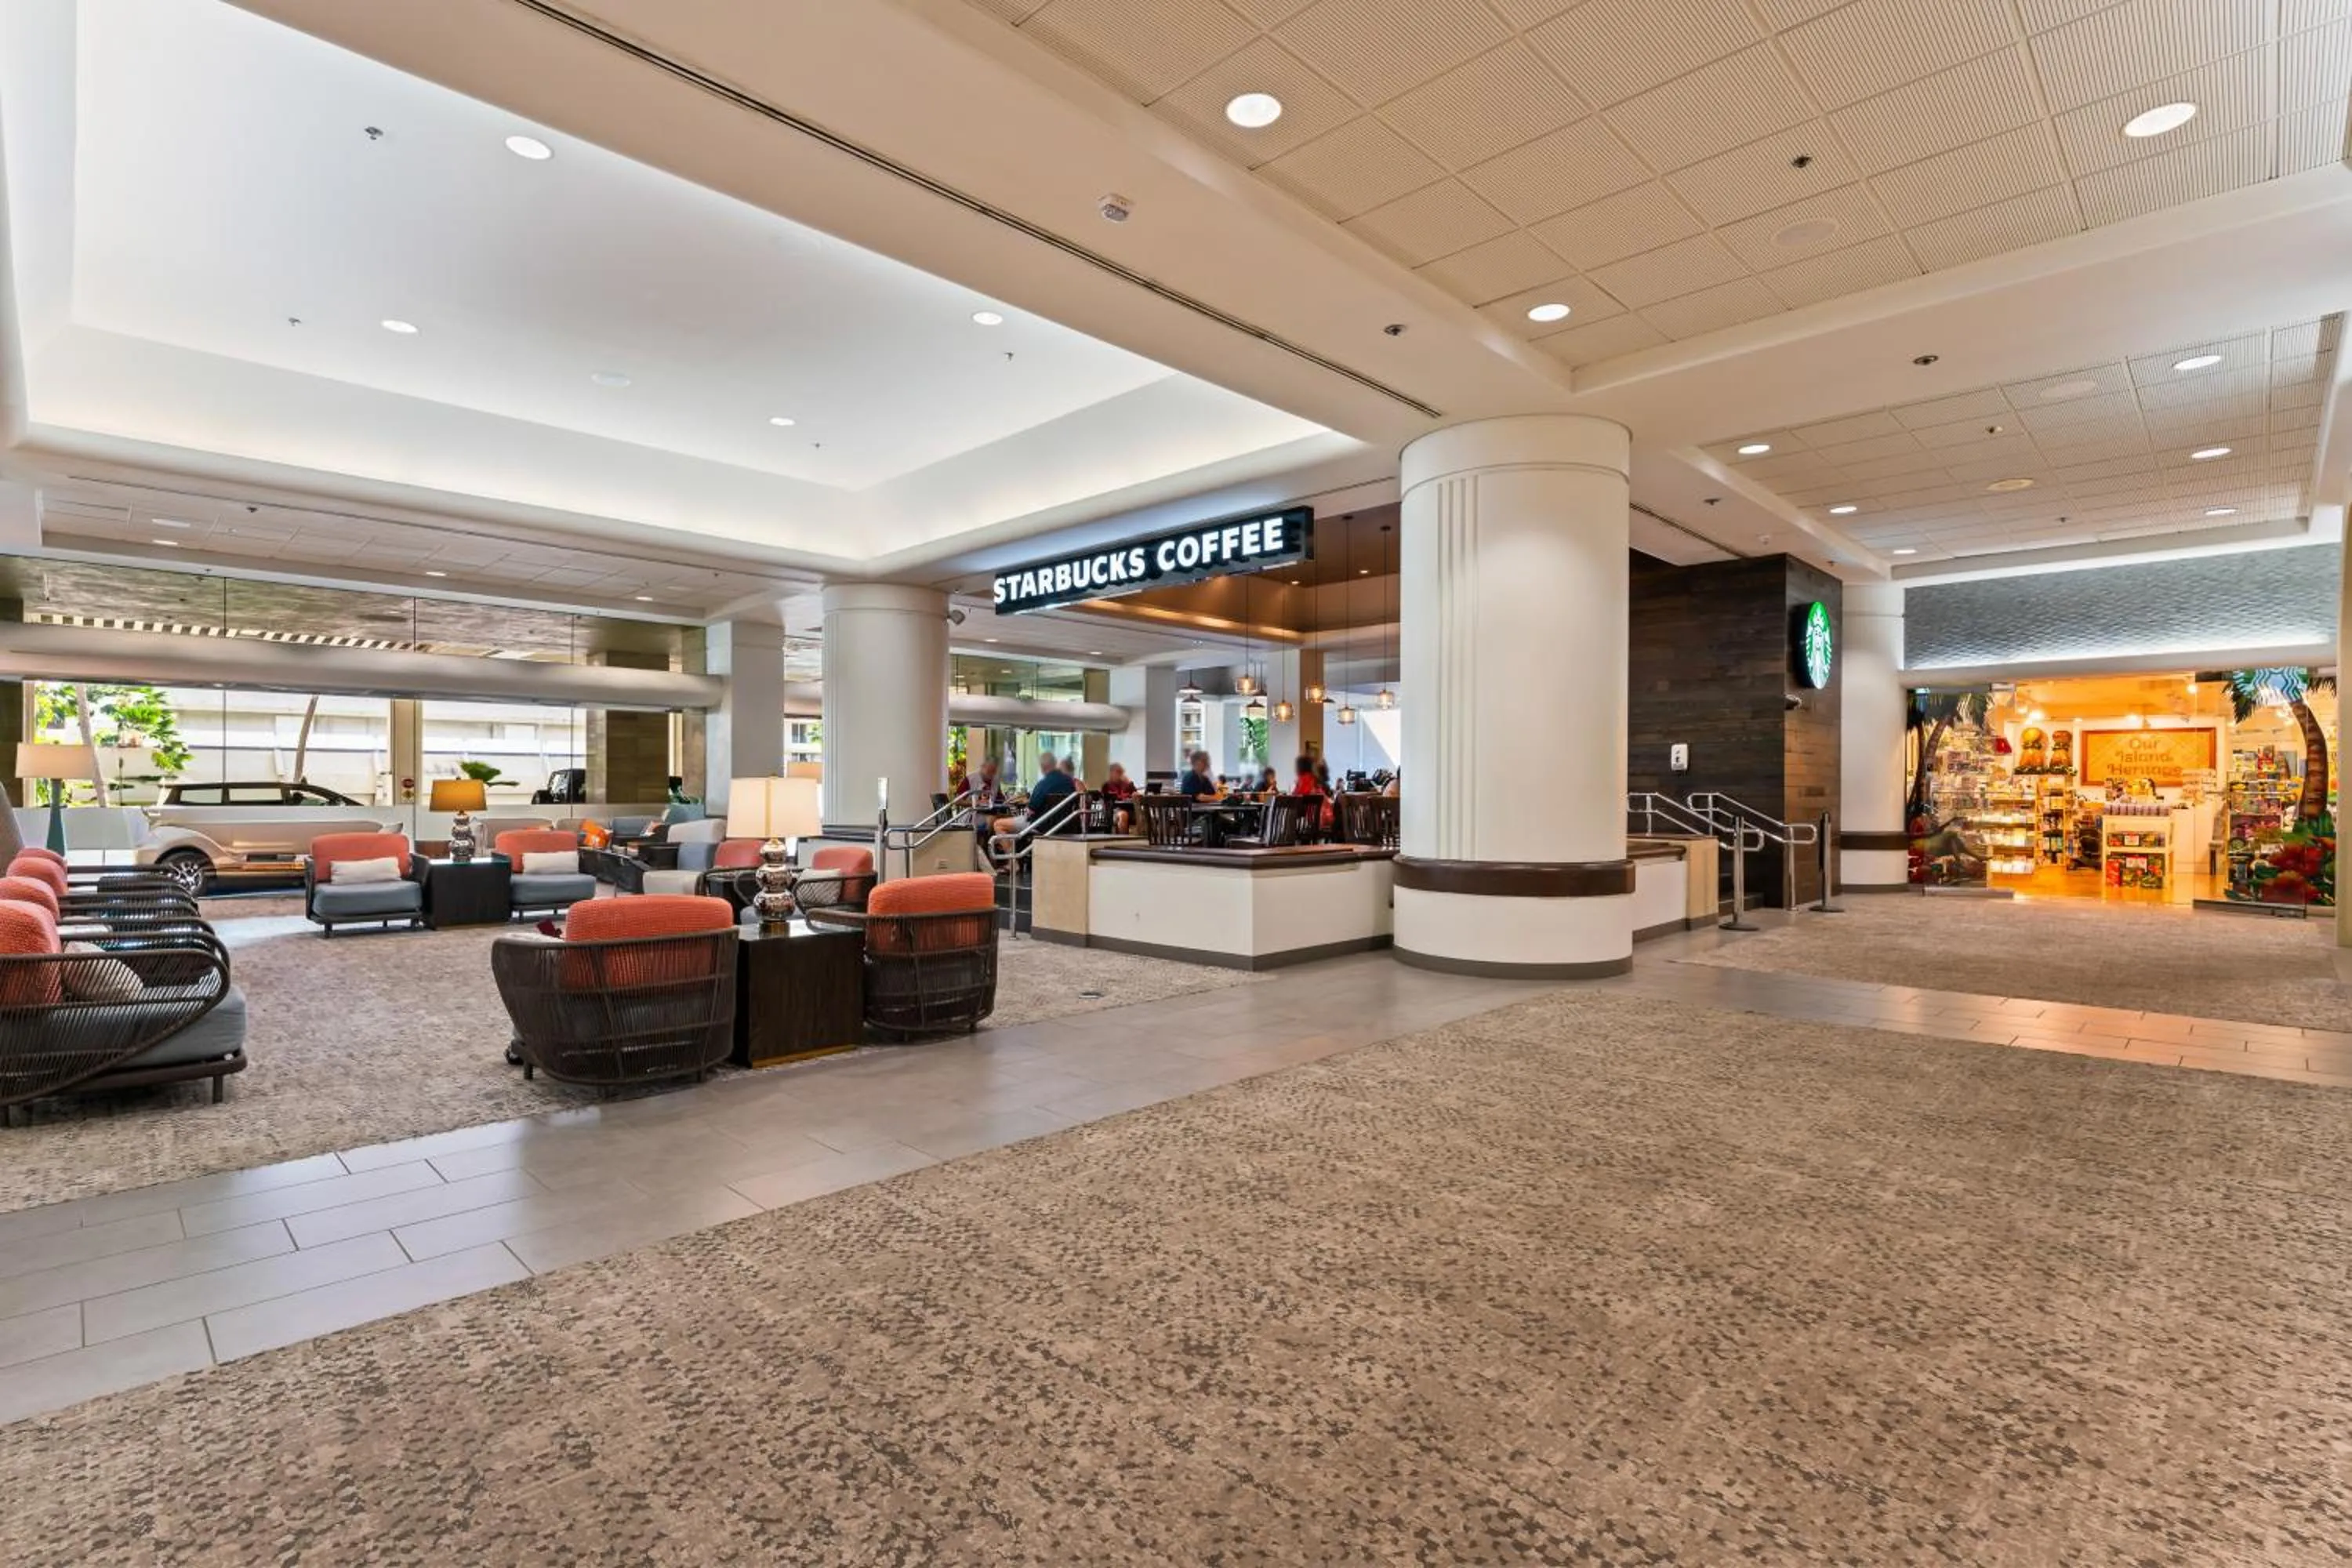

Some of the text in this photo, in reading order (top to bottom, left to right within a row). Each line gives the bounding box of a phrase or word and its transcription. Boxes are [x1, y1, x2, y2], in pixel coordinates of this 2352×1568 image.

[993, 517, 1284, 604] STARBUCKS COFFEE
[2129, 738, 2161, 750] Our
